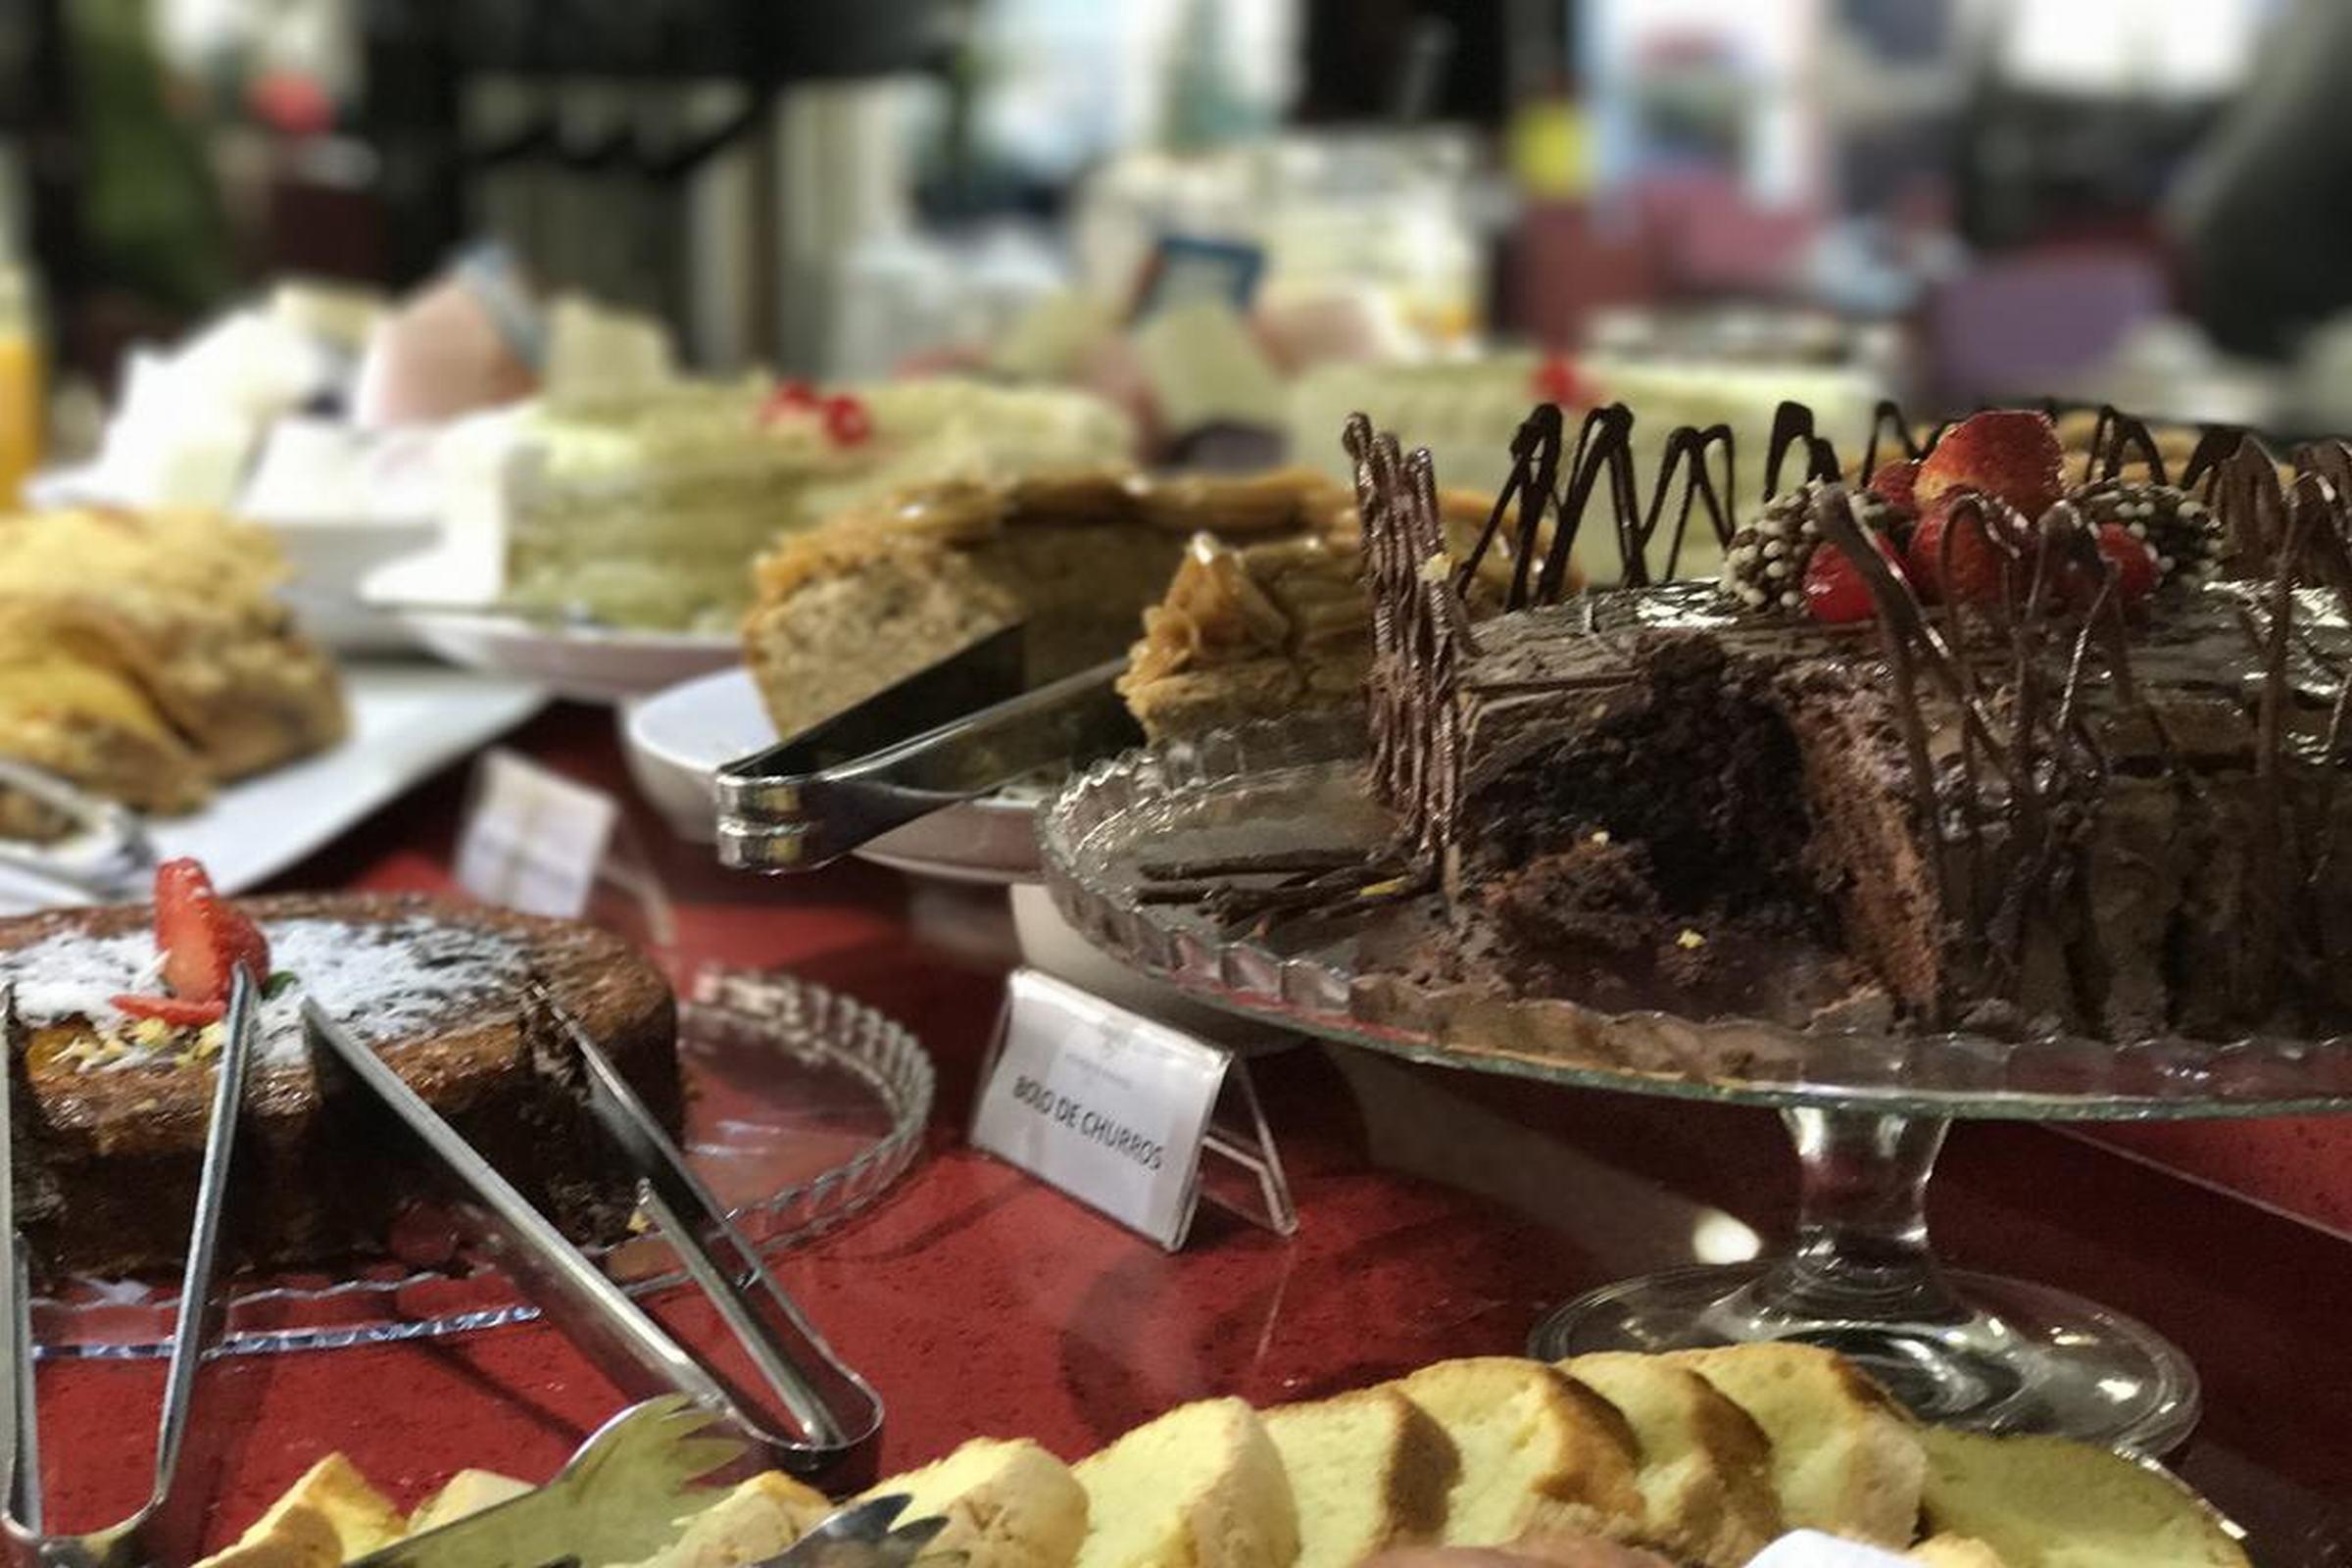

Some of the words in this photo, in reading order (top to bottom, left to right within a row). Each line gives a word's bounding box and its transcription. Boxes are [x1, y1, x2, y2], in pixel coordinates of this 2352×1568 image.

[1013, 1075, 1054, 1114] BOLO
[1055, 1097, 1081, 1128] DE
[1081, 1110, 1163, 1170] CHURROS
